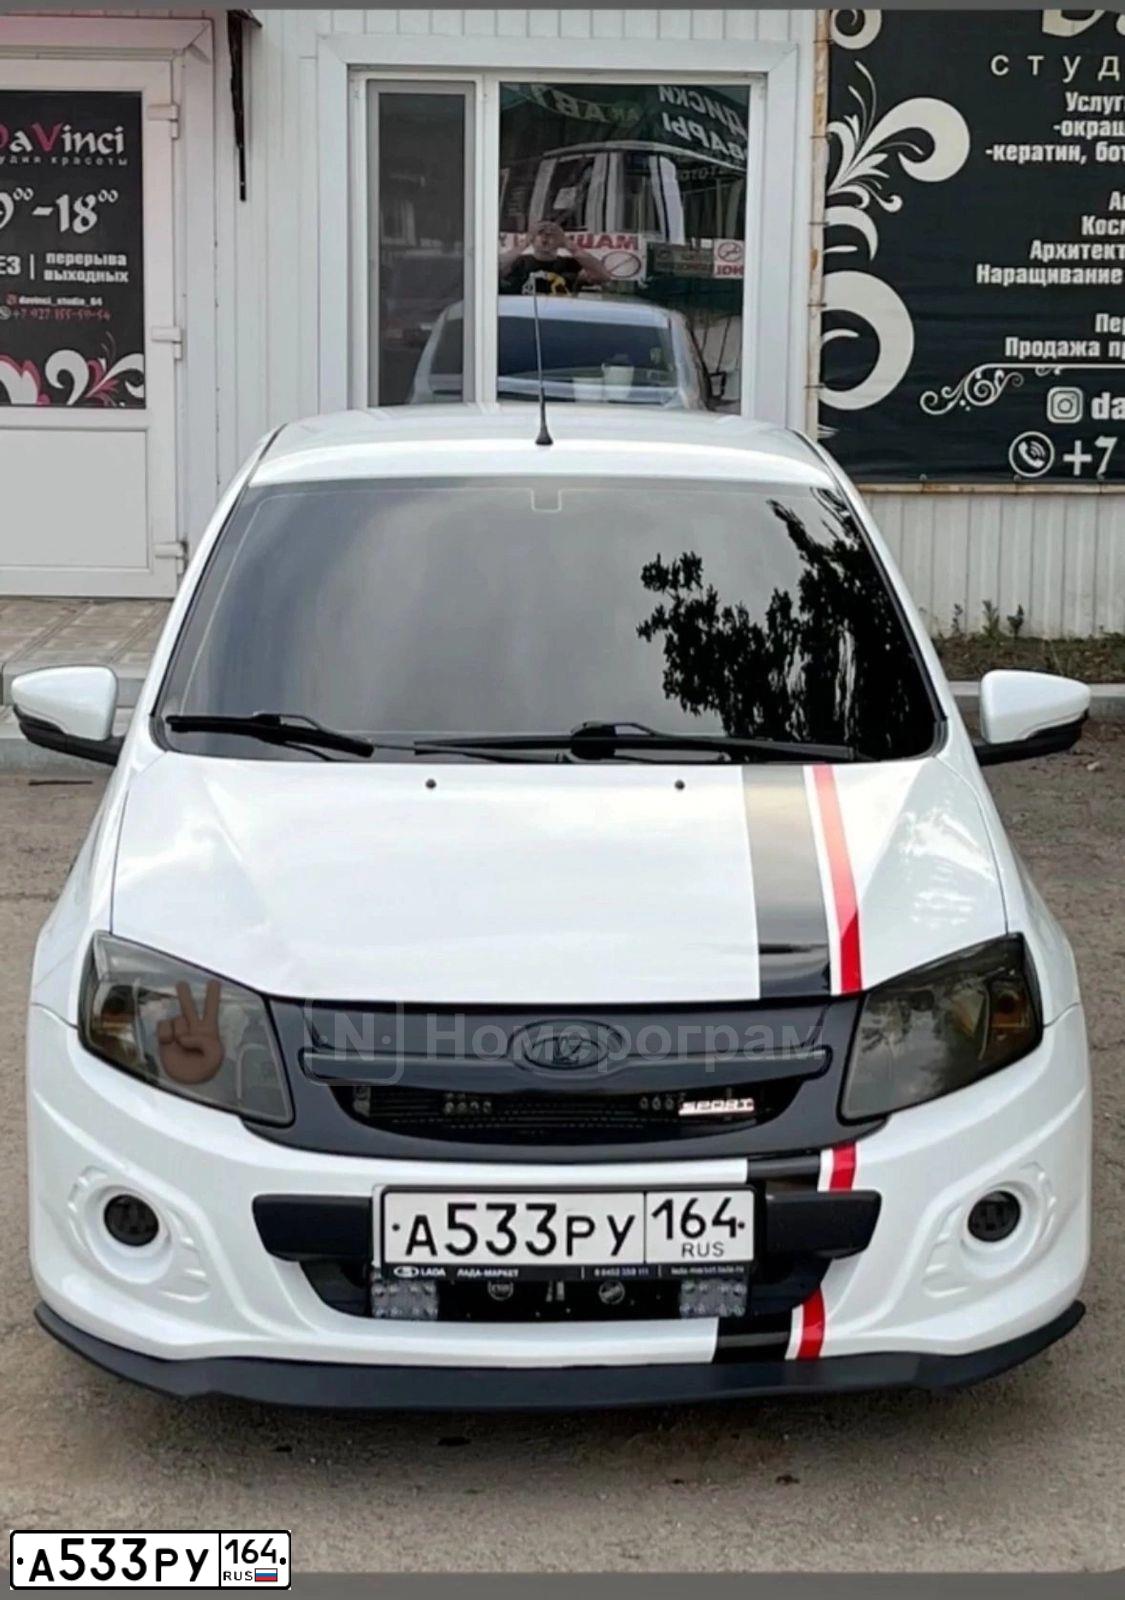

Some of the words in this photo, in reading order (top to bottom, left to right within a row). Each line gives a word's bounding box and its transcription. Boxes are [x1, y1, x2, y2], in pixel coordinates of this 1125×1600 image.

[1065, 91, 1125, 115] Услуг
[985, 143, 1087, 165] -кератин,
[1108, 191, 1125, 211] А
[45, 252, 128, 269] перерыва
[1029, 239, 1125, 263] Архитект
[43, 268, 129, 284] выходных
[976, 263, 1123, 288] Наращивание
[1005, 336, 1101, 361] Продажа
[1108, 339, 1125, 361] п
[1062, 435, 1118, 478] +7
[650, 1197, 738, 1241] 164
[681, 1242, 725, 1259] RUS
